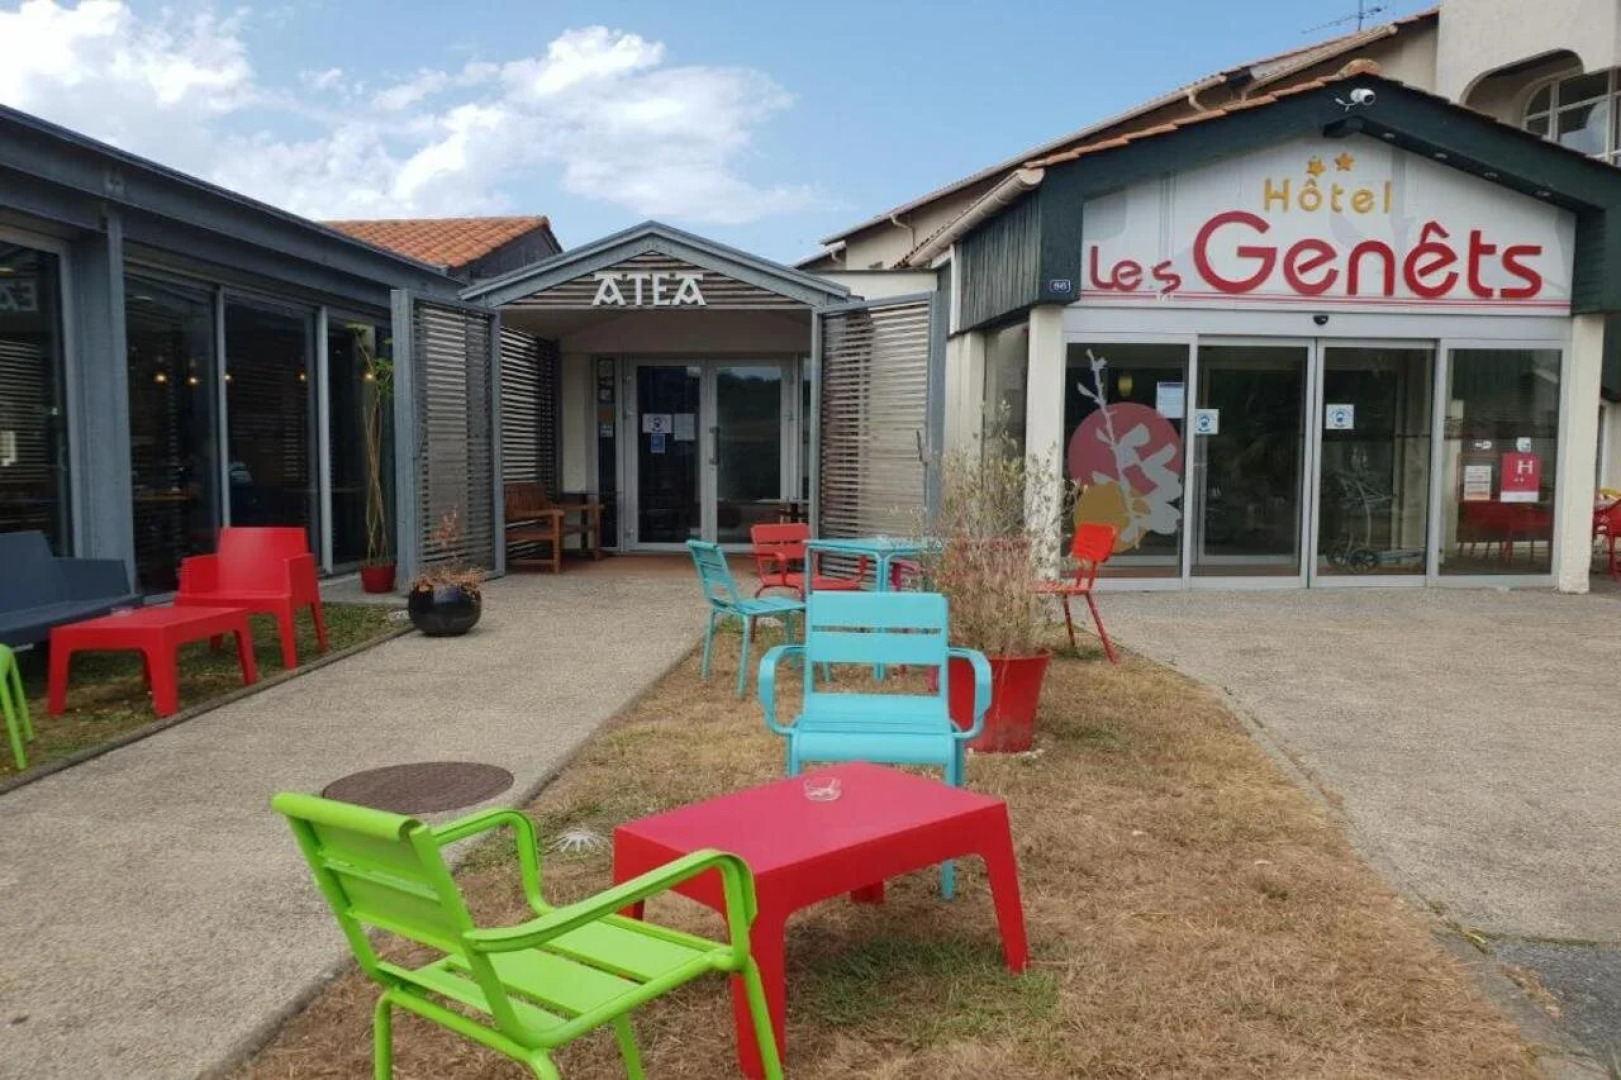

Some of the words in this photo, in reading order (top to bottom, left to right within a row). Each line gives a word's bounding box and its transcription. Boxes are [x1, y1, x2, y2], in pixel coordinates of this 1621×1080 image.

[1264, 178, 1392, 214] Hôtel
[1090, 245, 1182, 294] Les
[1194, 210, 1542, 299] Genêts
[592, 273, 706, 306] ATEA
[1517, 460, 1533, 475] H
